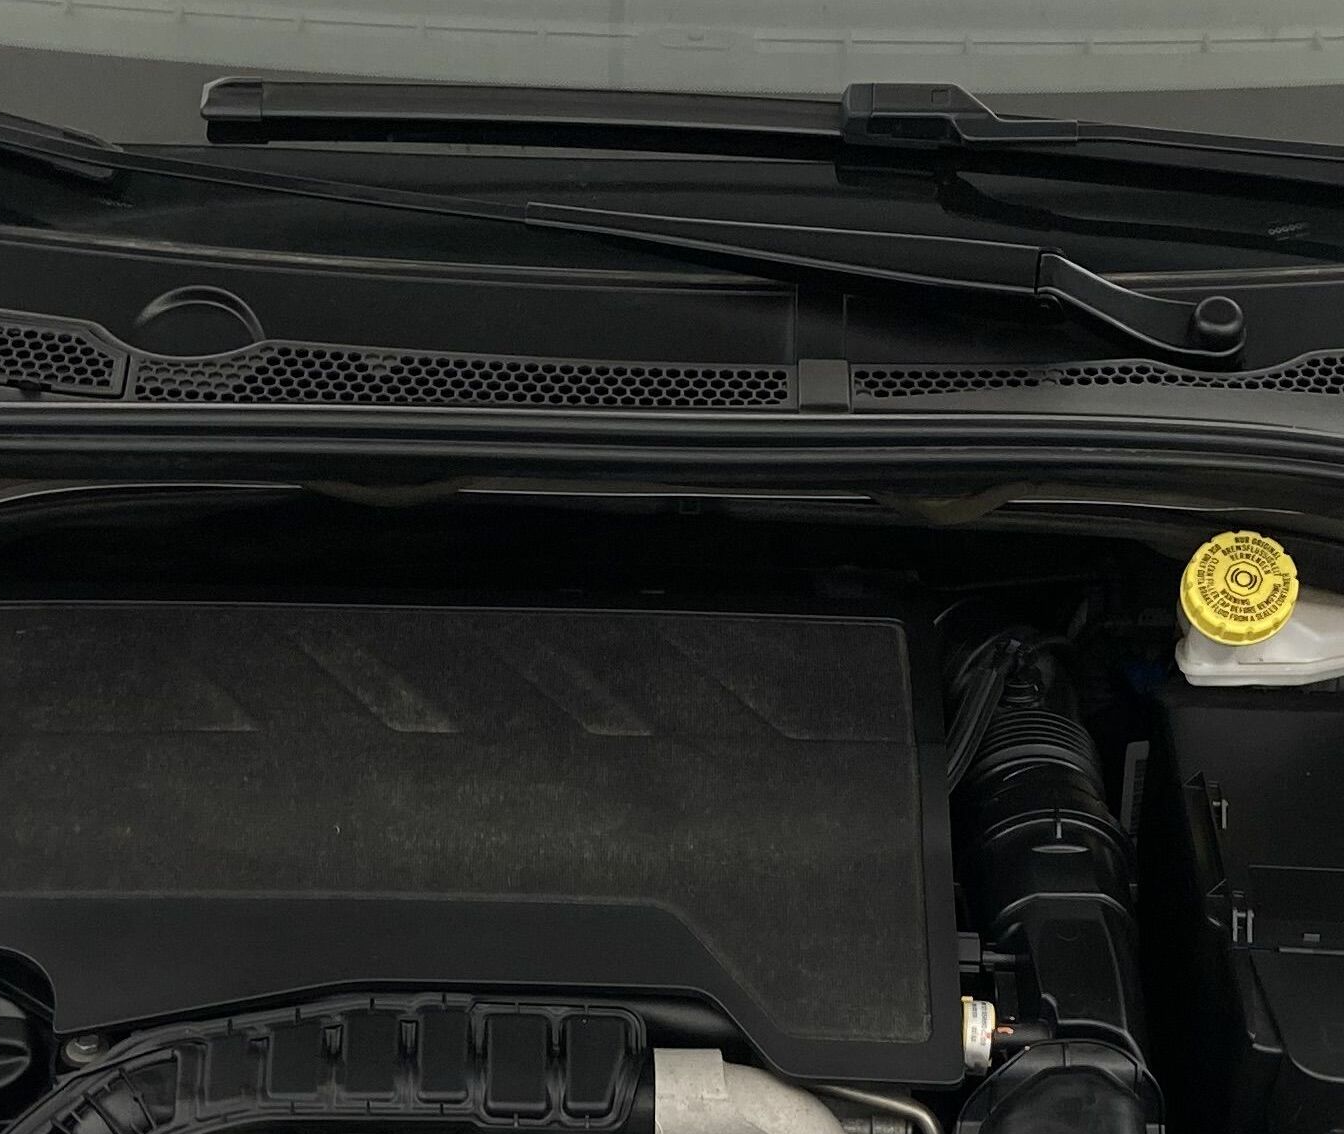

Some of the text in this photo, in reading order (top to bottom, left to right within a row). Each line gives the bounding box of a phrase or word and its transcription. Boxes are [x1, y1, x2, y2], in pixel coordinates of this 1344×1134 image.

[1252, 538, 1281, 560] ORIGINAL
[1230, 553, 1271, 574] VERWENDEN
[1217, 598, 1230, 609] CAP
[1229, 613, 1249, 622] FROM
